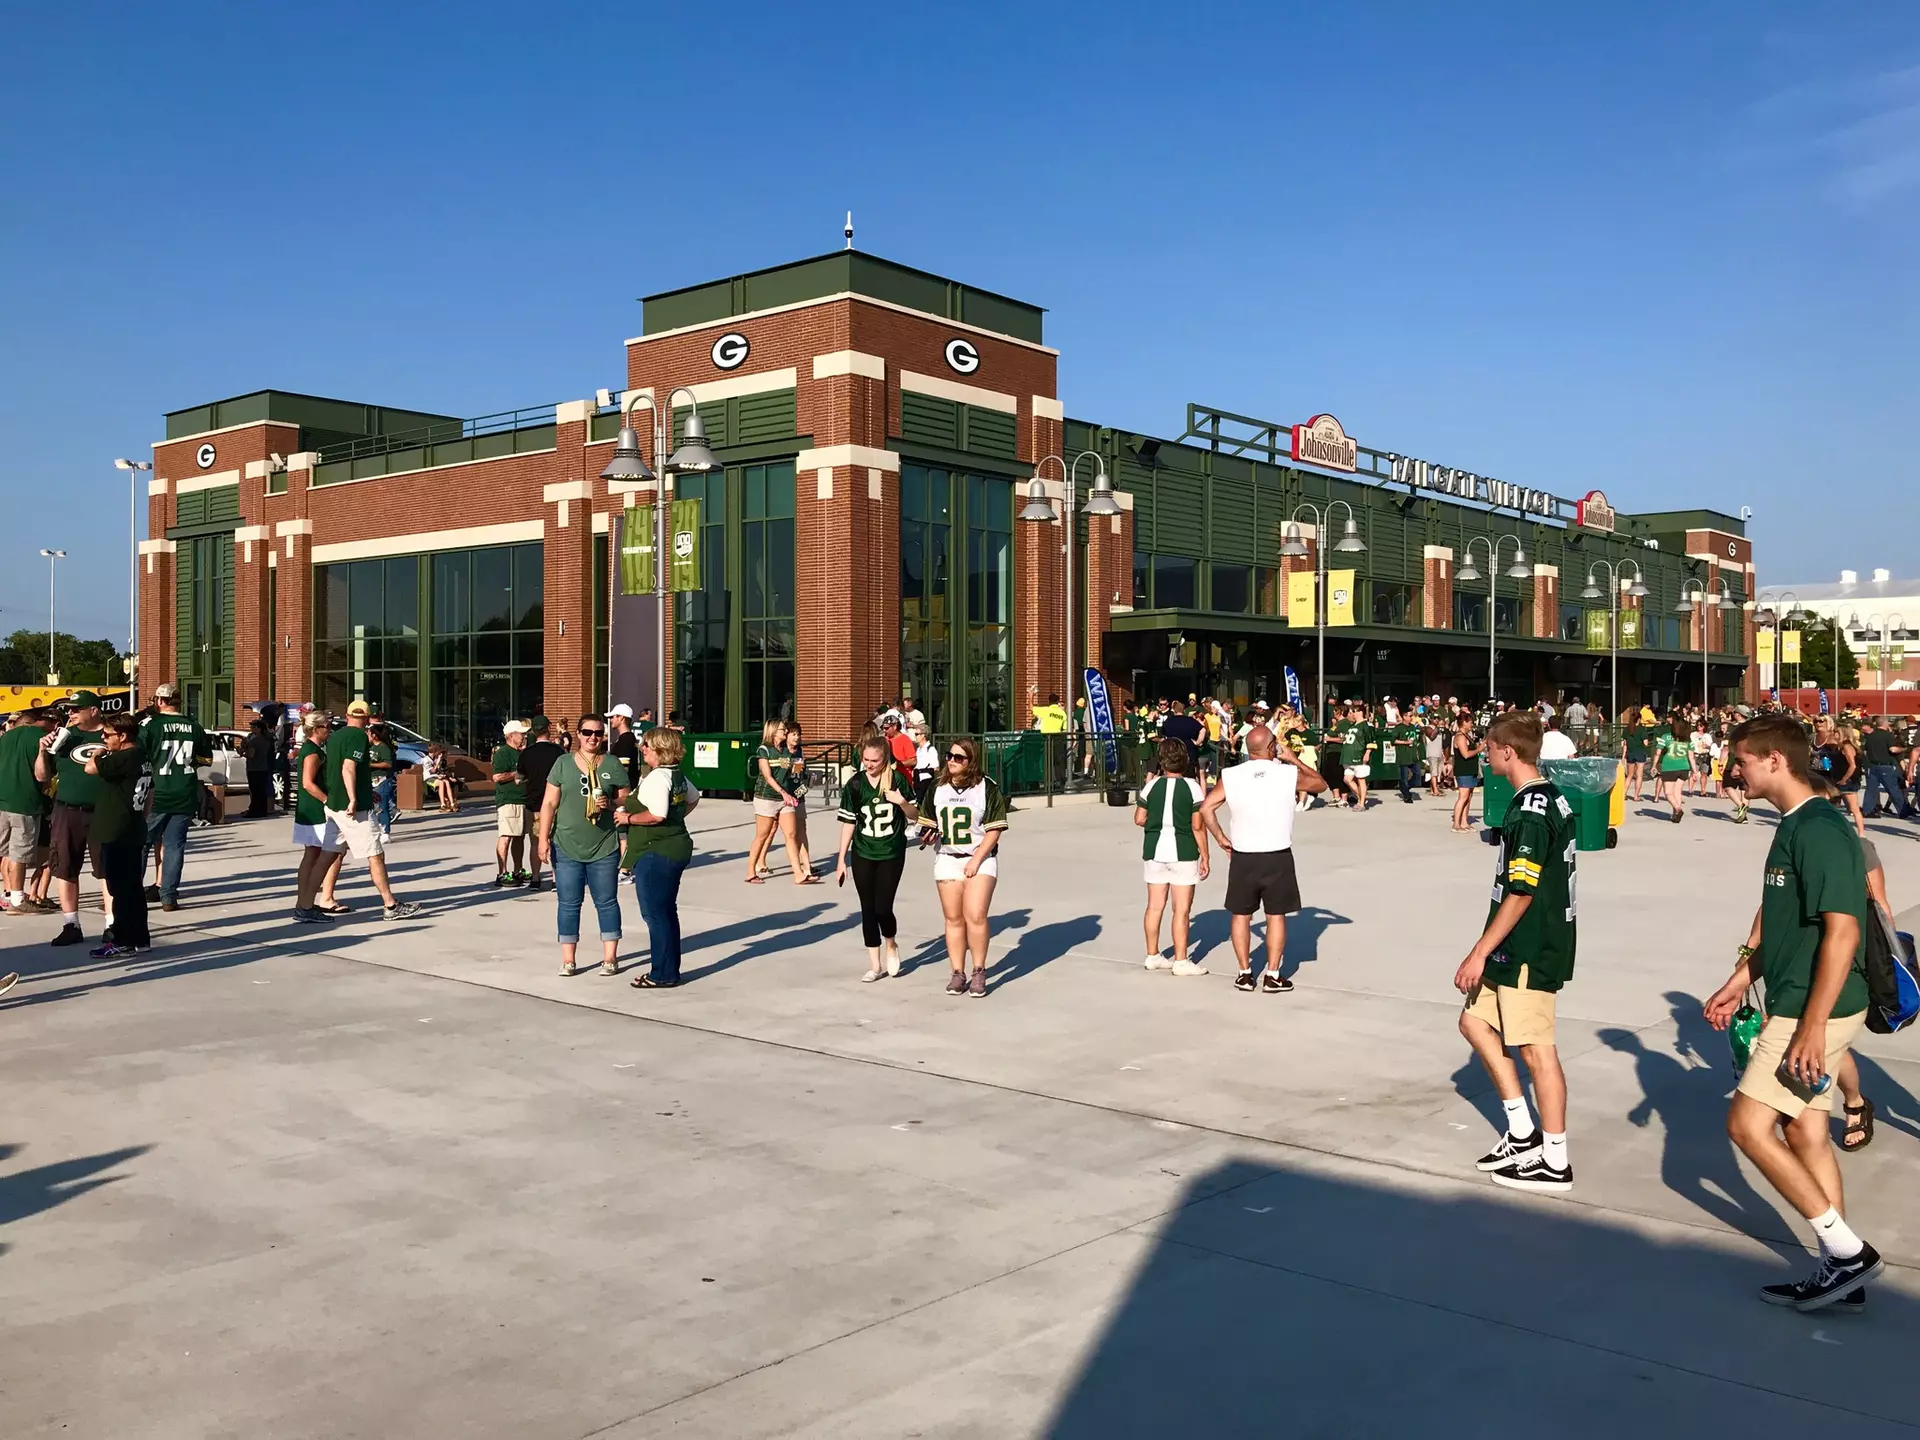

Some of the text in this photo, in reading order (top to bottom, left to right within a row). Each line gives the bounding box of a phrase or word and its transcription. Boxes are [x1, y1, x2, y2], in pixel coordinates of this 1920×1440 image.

[711, 333, 750, 371] G
[944, 338, 980, 375] G
[196, 443, 216, 469] G
[1301, 429, 1355, 467] Johnsonville
[1389, 452, 1555, 516] TAILGATE VILLAGE
[1584, 503, 1613, 529] Johnsonville
[1728, 541, 1736, 557] G
[1089, 673, 1110, 733] WIXX
[159, 740, 194, 775] 74
[860, 803, 894, 838] 12
[1521, 793, 1547, 816] 12
[939, 806, 973, 846] 12
